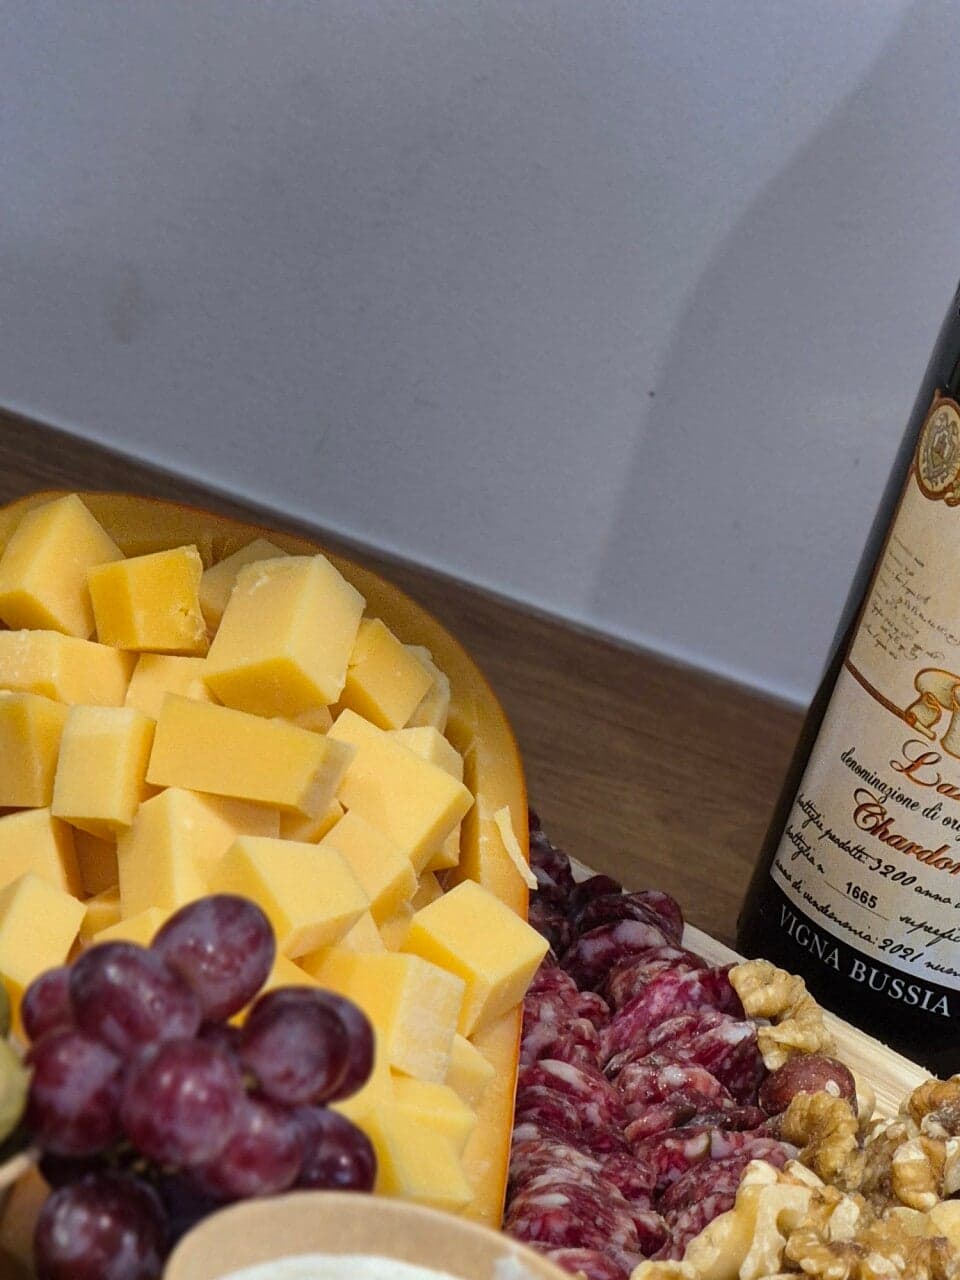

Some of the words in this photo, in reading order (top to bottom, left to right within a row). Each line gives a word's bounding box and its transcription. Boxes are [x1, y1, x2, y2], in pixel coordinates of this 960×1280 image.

[841, 747, 920, 811] denominazione
[922, 802, 944, 820] di
[845, 881, 879, 909] 1665
[868, 858, 918, 887] 3200
[915, 885, 952, 905] anno
[792, 877, 802, 893] di
[878, 938, 924, 963] 2021
[779, 904, 841, 971] VIGNA
[850, 959, 951, 1017] BUSSIA
